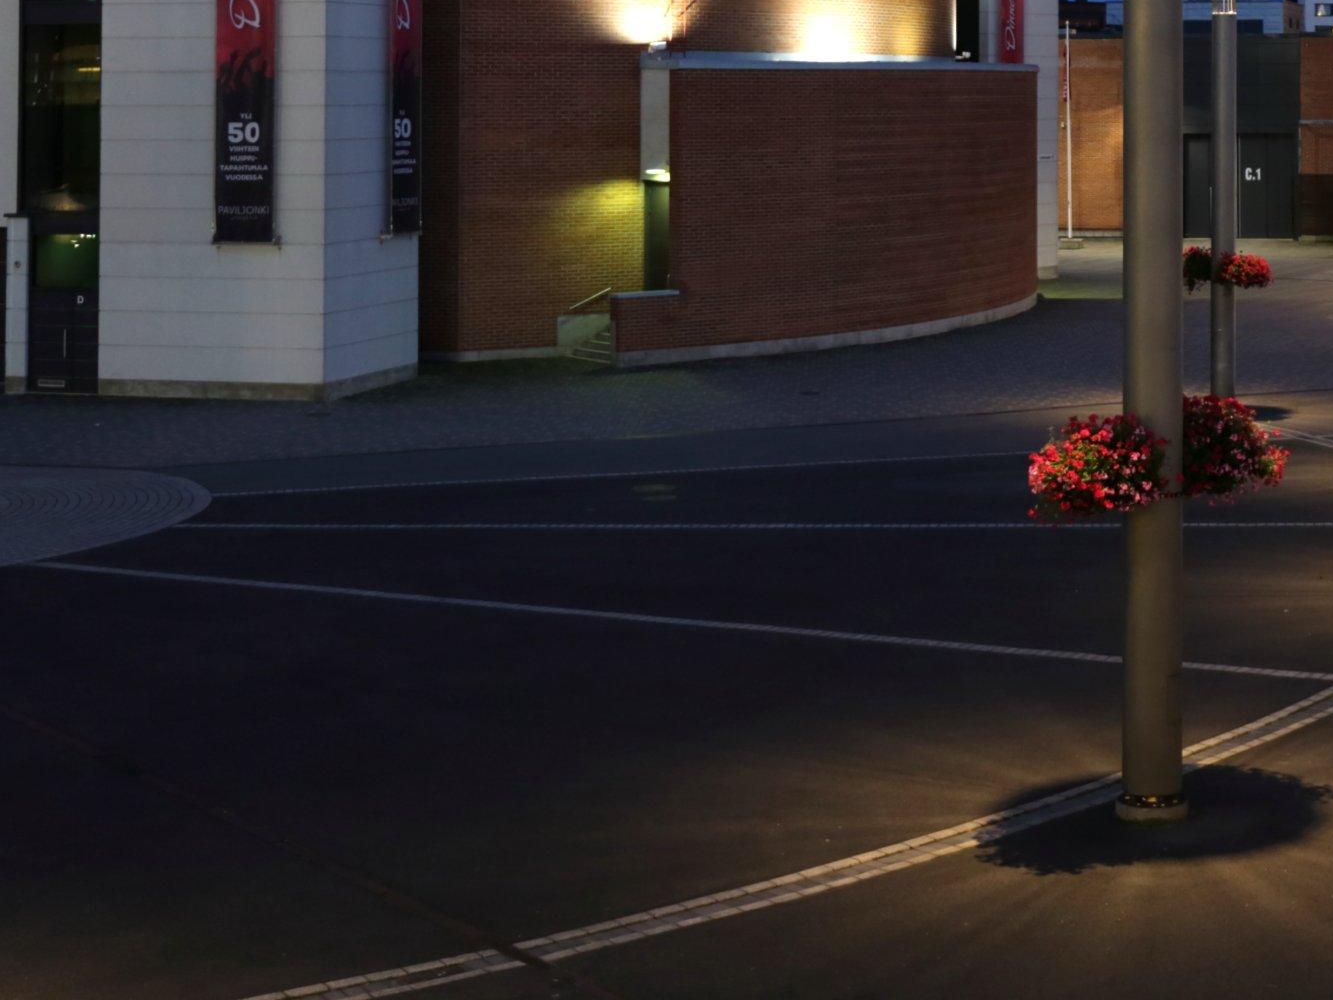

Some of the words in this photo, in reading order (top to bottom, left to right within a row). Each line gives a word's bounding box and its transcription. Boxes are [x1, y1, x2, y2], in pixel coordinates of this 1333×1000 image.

[227, 121, 260, 143] 50
[393, 117, 412, 139] 50
[1244, 167, 1261, 181] C.1
[217, 204, 270, 215] PAVILJONKI
